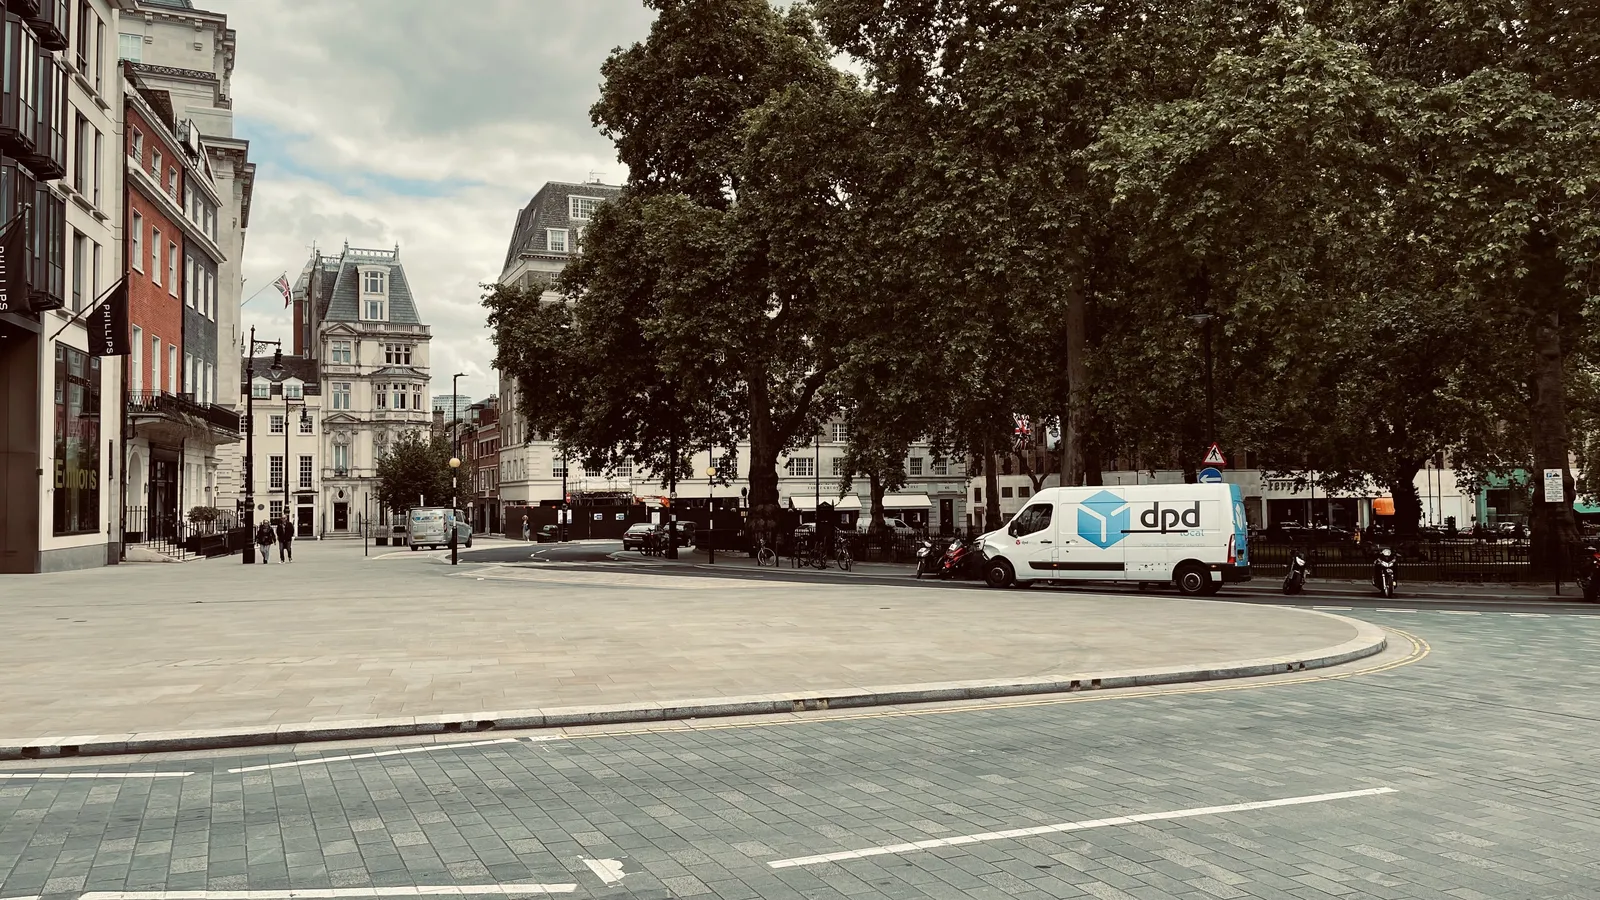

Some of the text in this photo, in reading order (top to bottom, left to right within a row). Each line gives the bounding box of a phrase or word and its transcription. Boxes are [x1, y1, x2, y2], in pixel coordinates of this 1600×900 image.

[103, 304, 114, 354] PHILLIPS
[1268, 479, 1311, 491] Ferri
[1140, 501, 1200, 534] dpd
